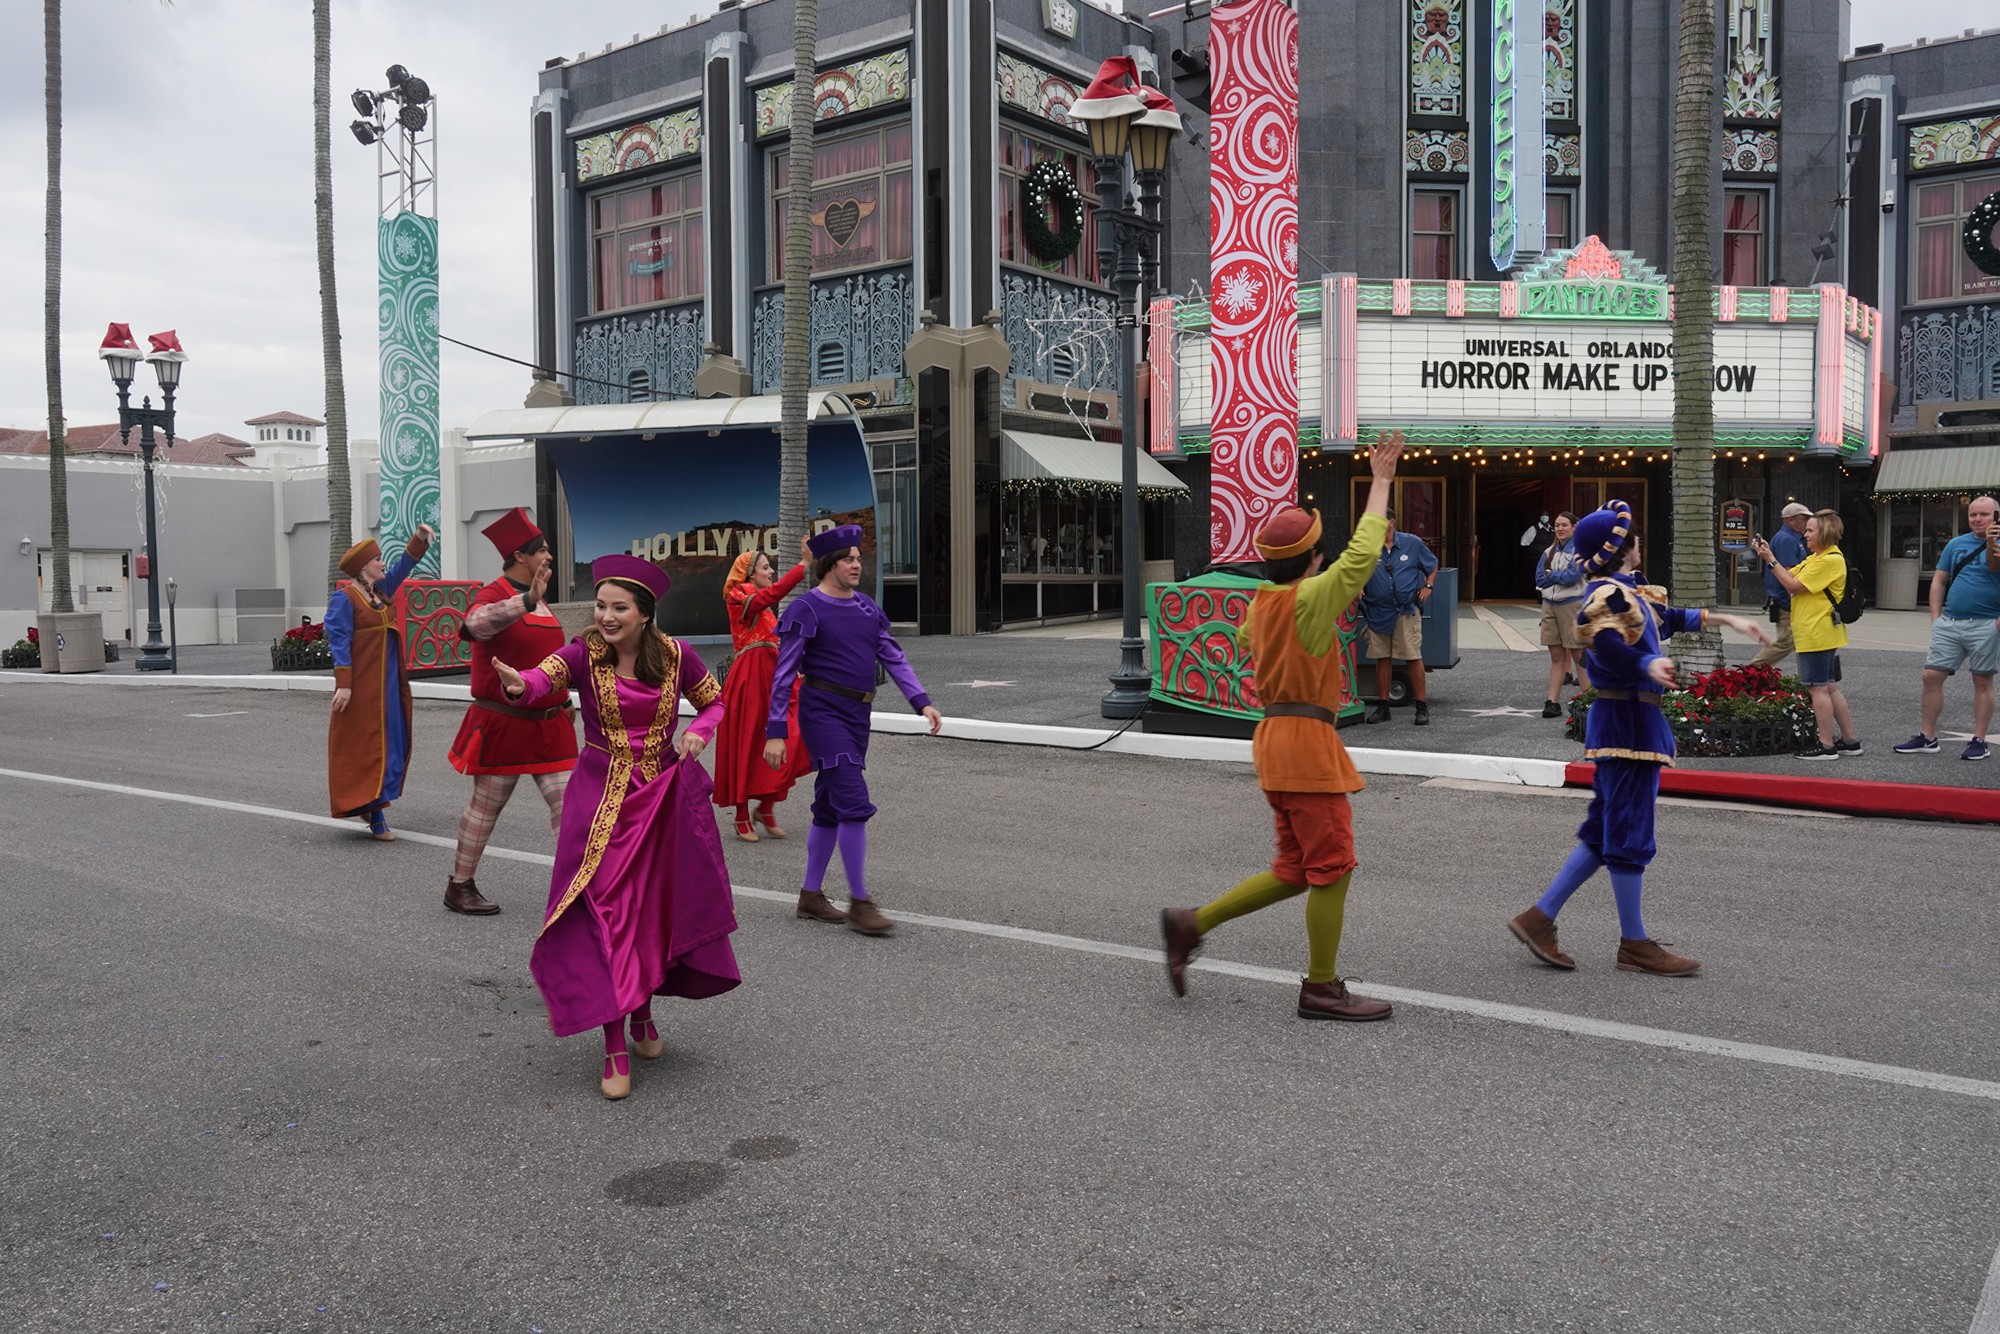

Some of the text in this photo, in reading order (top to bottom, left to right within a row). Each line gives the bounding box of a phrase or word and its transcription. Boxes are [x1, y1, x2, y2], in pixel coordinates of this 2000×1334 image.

[1528, 284, 1660, 316] PANTAGES
[1465, 339, 1570, 357] UNIVERSAL
[1421, 360, 1757, 393] HORROR MAKE UP OW
[631, 518, 837, 561] HOLLYWOD
